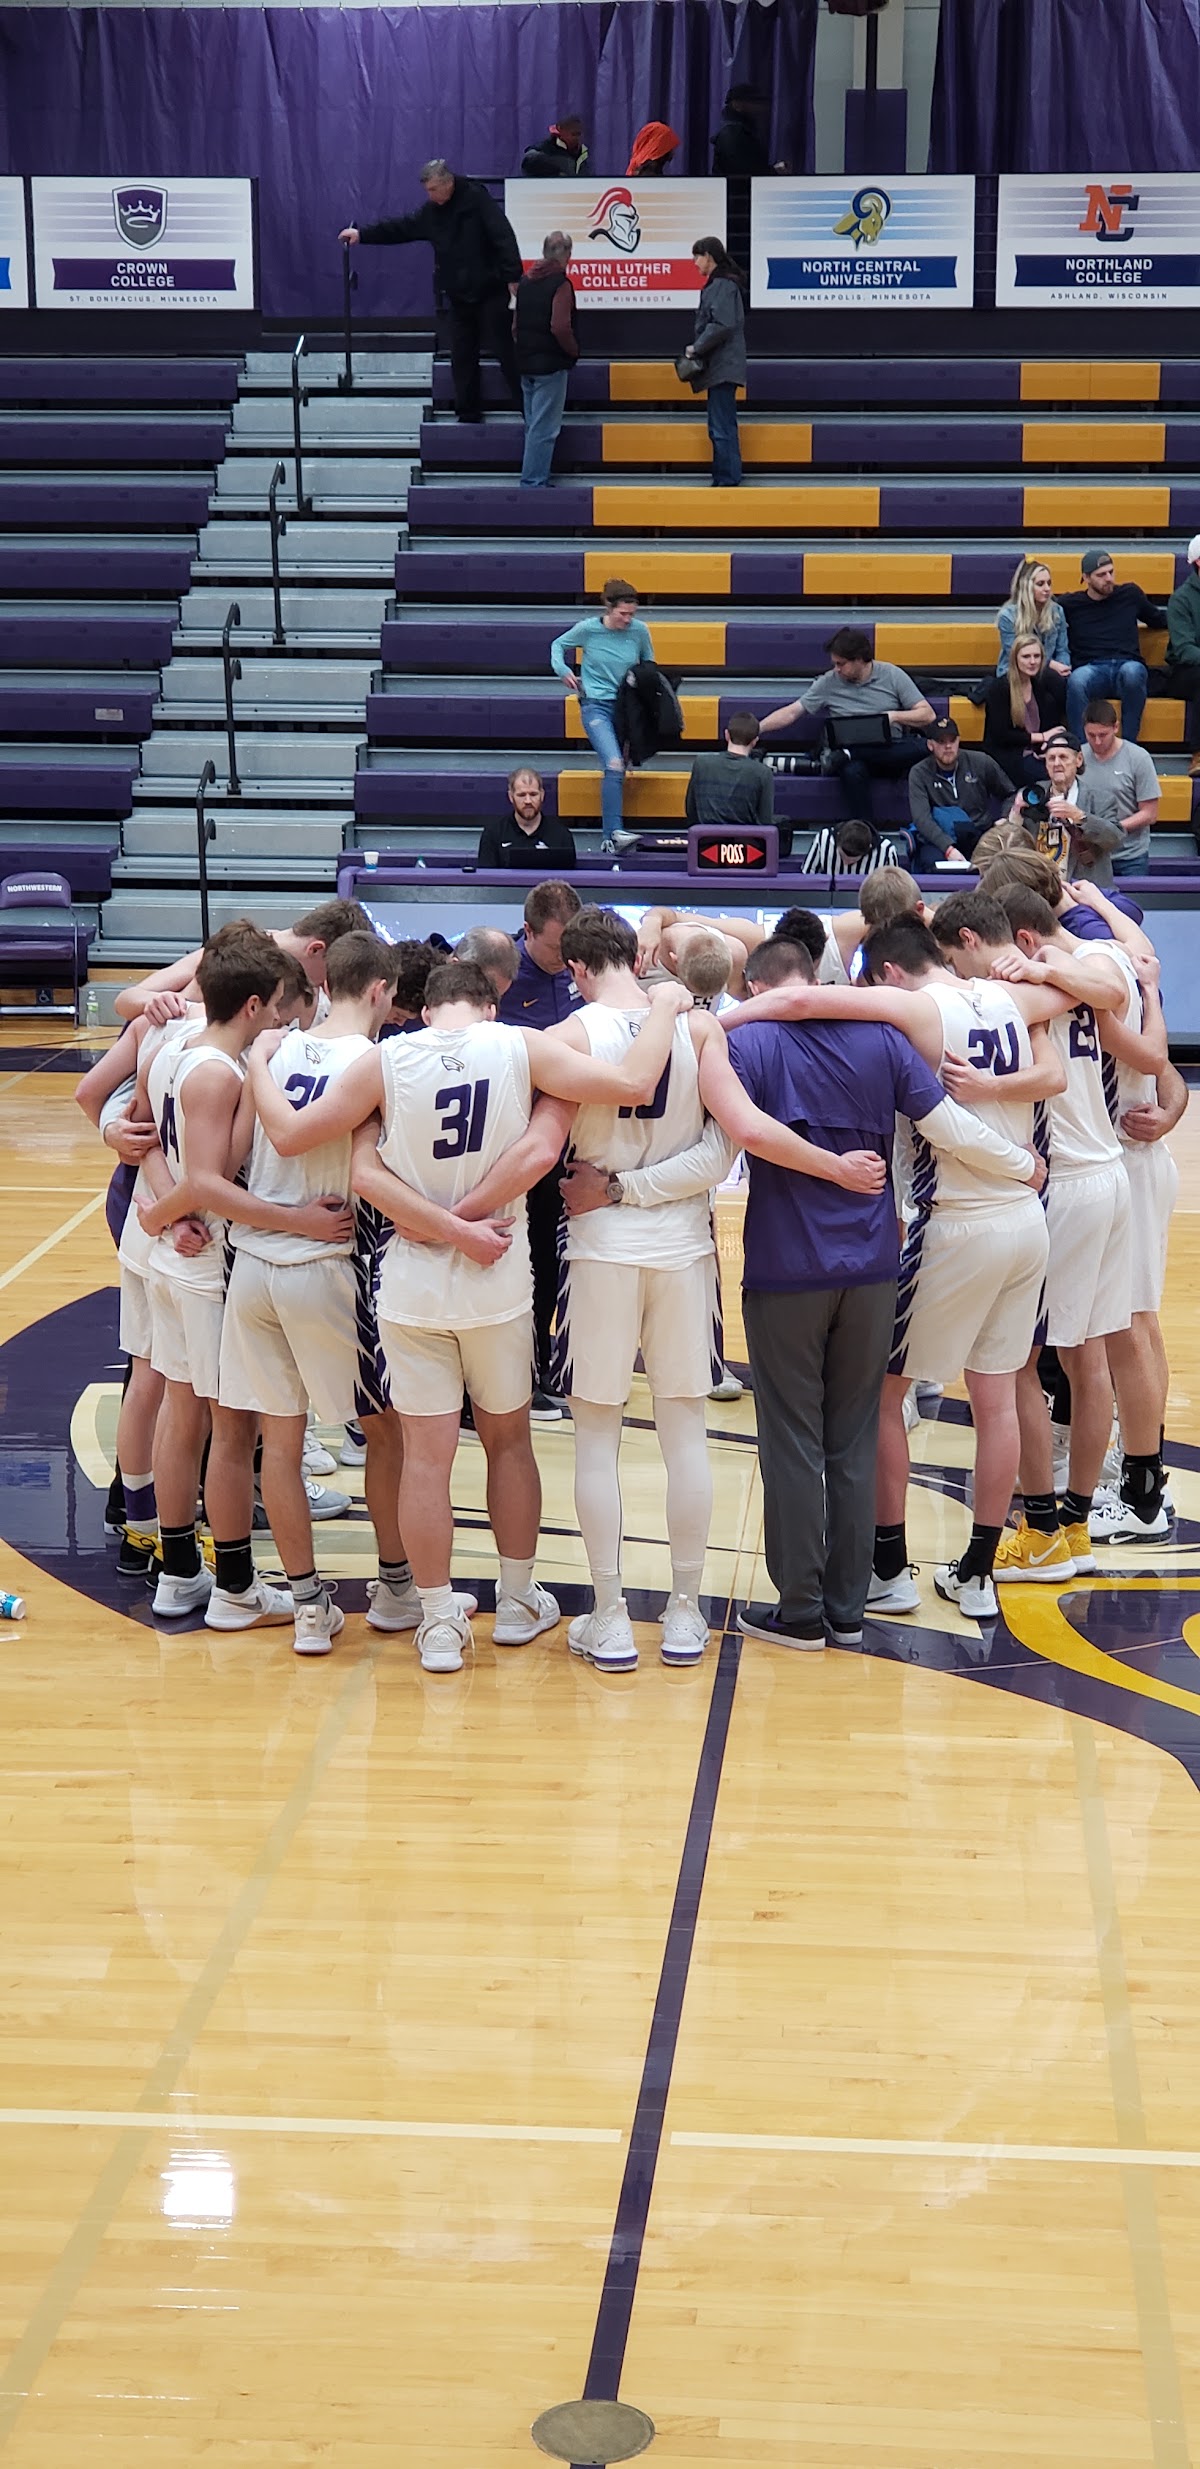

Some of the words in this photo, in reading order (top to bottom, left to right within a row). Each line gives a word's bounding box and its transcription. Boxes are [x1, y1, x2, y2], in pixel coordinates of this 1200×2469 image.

[117, 262, 168, 274] CROWN
[616, 263, 671, 274] LUTHER
[802, 261, 851, 273] NORTH
[855, 260, 921, 272] CENTRAL
[1065, 258, 1153, 270] NORTHLAND
[110, 275, 175, 287] COLLEGE
[582, 276, 648, 288] COLLEGE
[819, 273, 903, 286] UNIVERSITY
[1075, 272, 1142, 284] COLLEGE
[69, 295, 83, 303] ST.
[89, 296, 155, 304] BONIFACIUS,
[790, 294, 866, 302] MINNEAPOLIS,
[871, 293, 931, 301] MINNESOTA
[1050, 293, 1103, 301] ASHLAND,
[1108, 292, 1168, 300] WISCONSIN
[720, 843, 744, 864] POSS
[6, 884, 63, 893] NORTHWESTERN
[432, 1078, 490, 1160] 31
